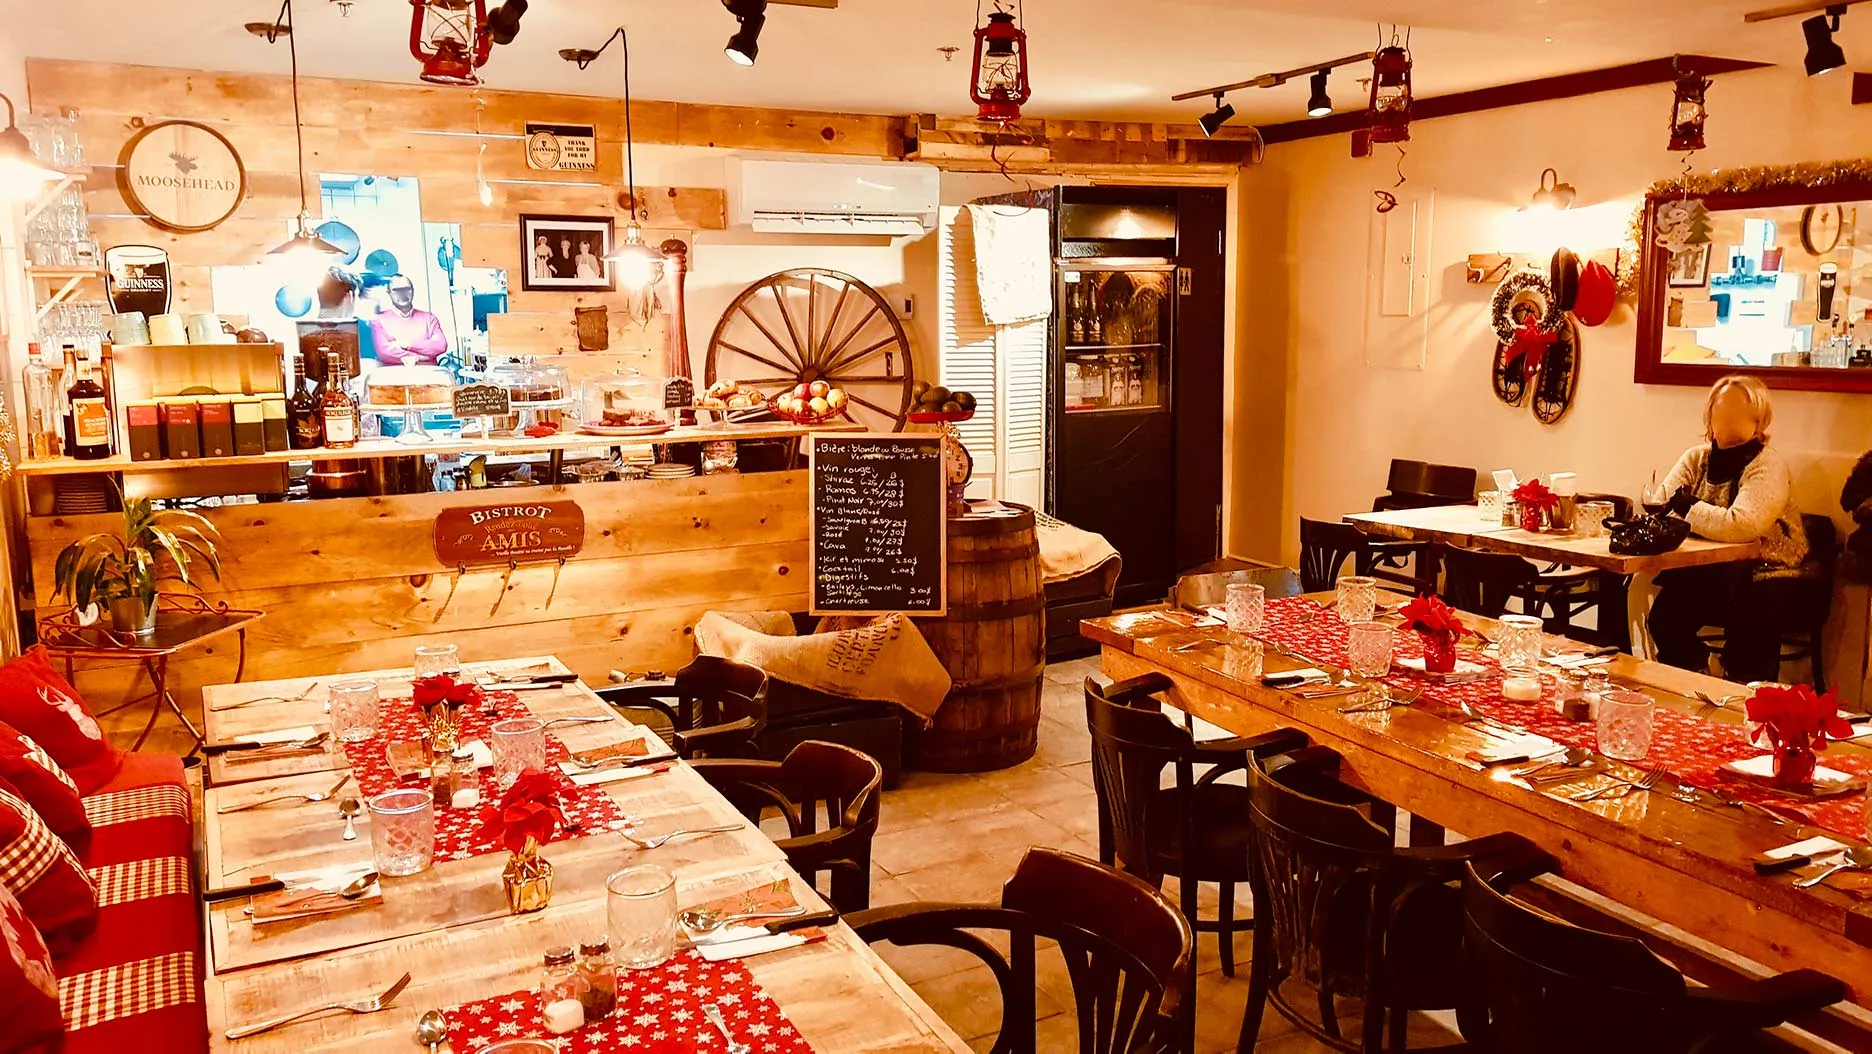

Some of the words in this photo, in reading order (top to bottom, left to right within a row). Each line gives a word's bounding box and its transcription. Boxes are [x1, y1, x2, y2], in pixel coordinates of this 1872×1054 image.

[137, 175, 236, 192] MOOSEHEAD
[118, 278, 164, 289] GUINNESS
[822, 464, 839, 473] Vin
[469, 505, 552, 525] BISTROT
[820, 506, 834, 514] Vin
[480, 530, 542, 552] AMIS
[823, 539, 846, 550] Cava
[825, 574, 869, 583] Digestifs
